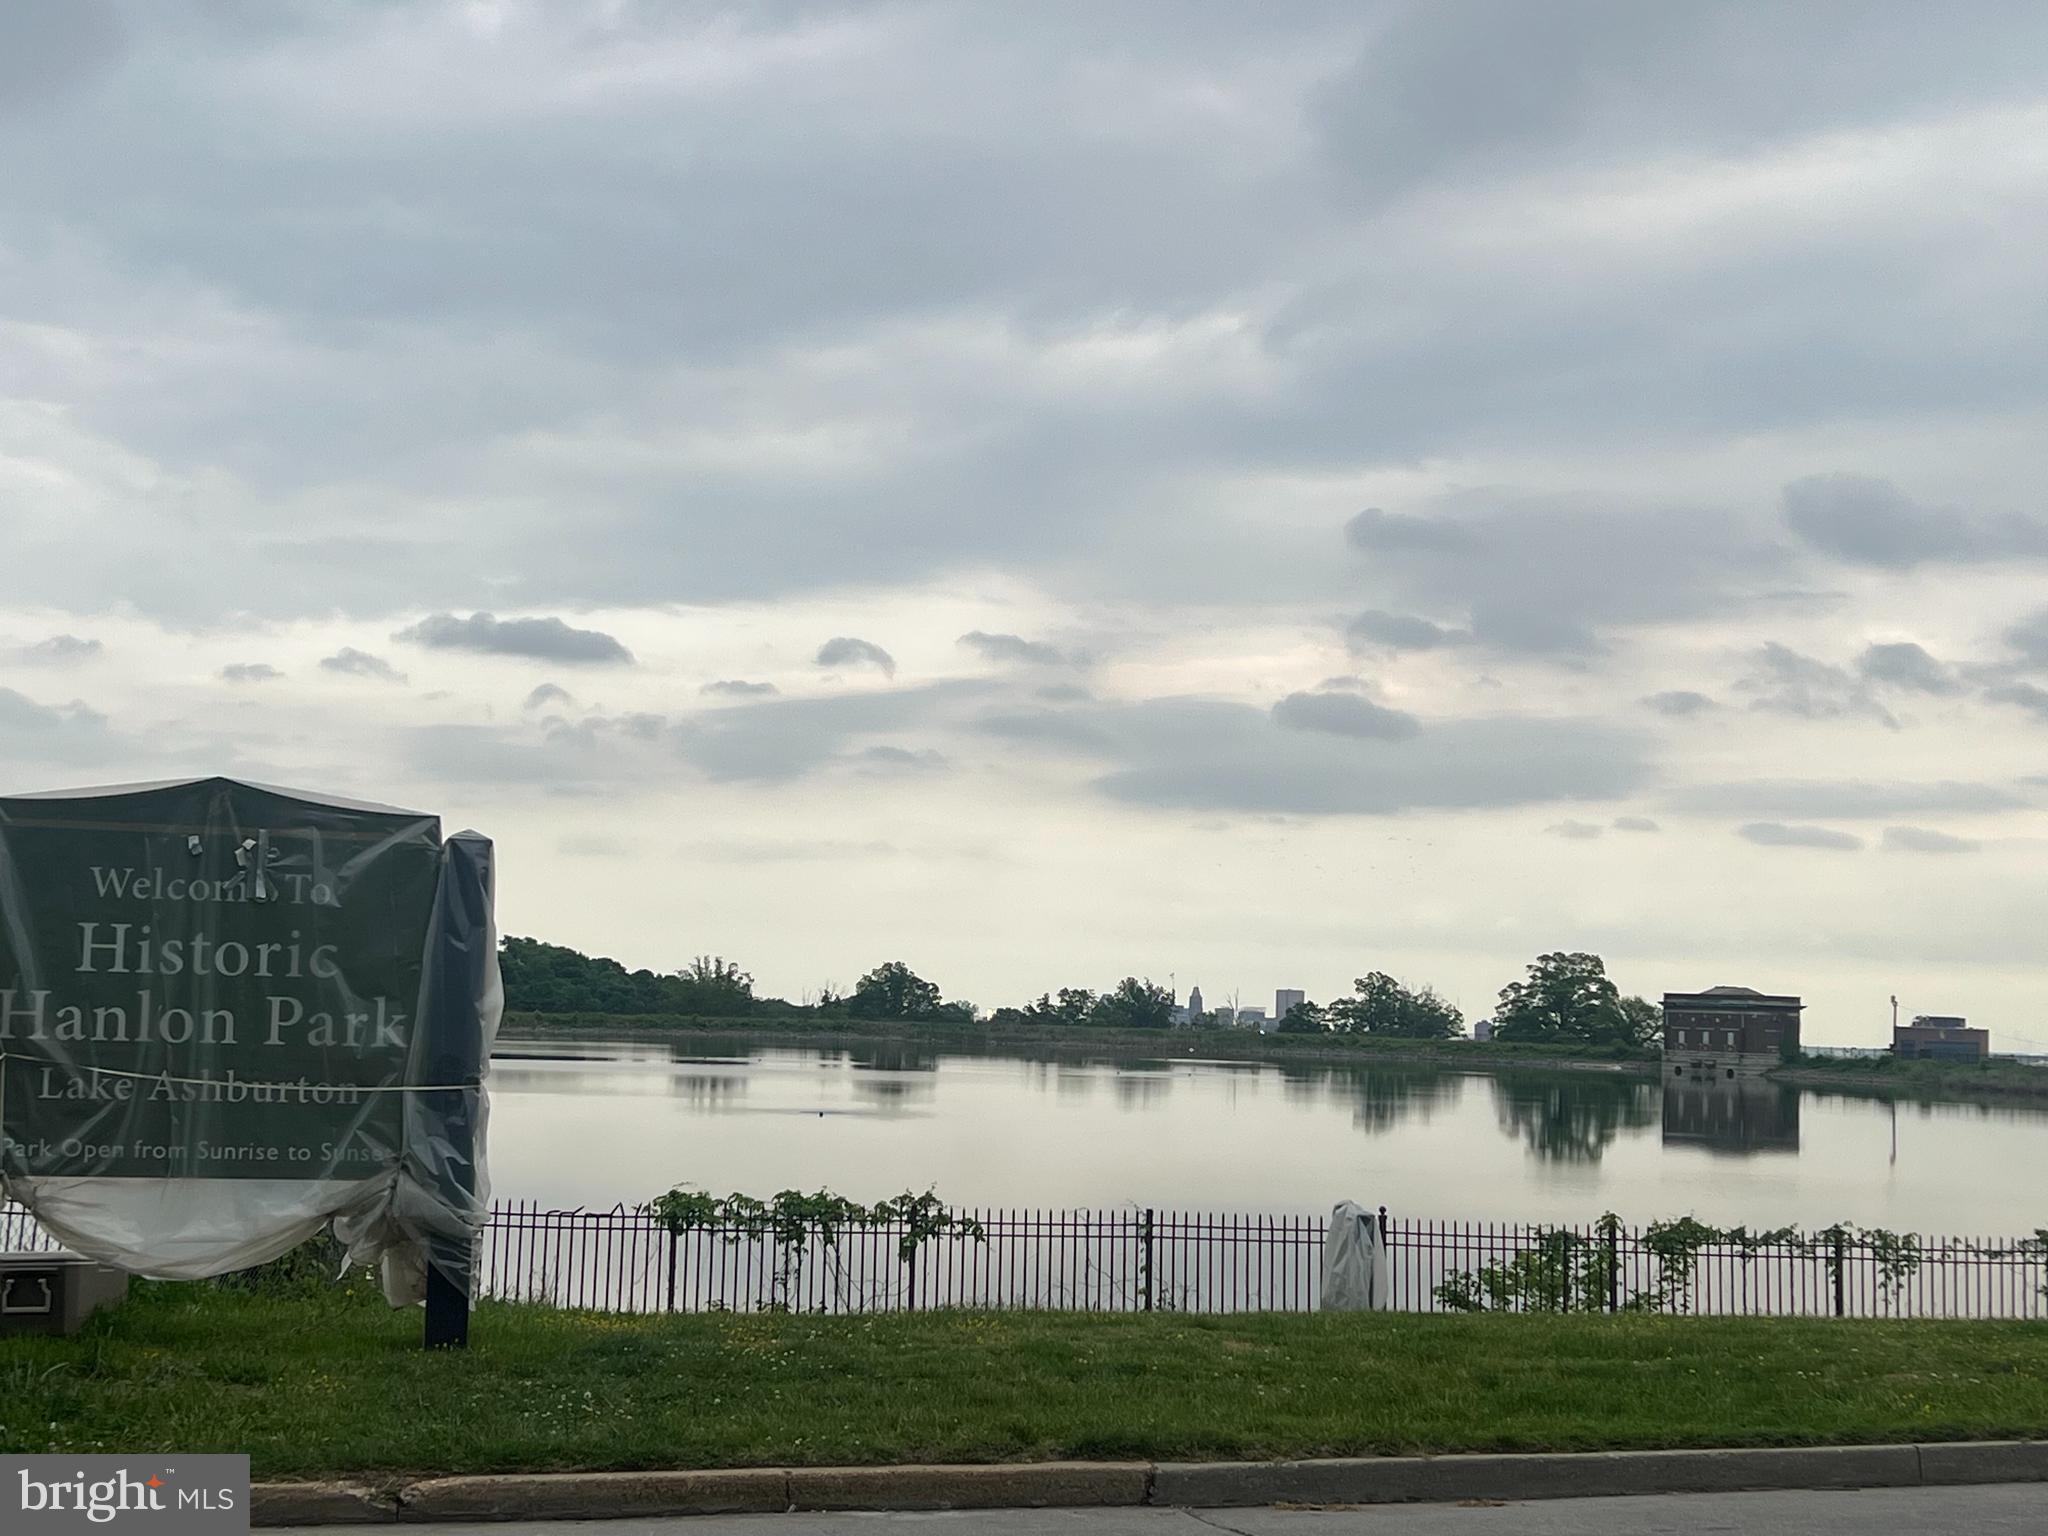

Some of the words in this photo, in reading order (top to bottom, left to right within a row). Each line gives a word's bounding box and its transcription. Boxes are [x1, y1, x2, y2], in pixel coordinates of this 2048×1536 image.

[285, 874, 331, 905] To
[75, 922, 338, 979] Historic
[0, 989, 238, 1044] Hanlon
[264, 996, 408, 1048] Park
[38, 1067, 133, 1101] Lake
[150, 1069, 359, 1105] Ashburton
[3, 1137, 51, 1157] Park
[62, 1138, 124, 1163] Open
[134, 1140, 186, 1159] from
[197, 1140, 279, 1161] Sunrise
[288, 1147, 311, 1162] to
